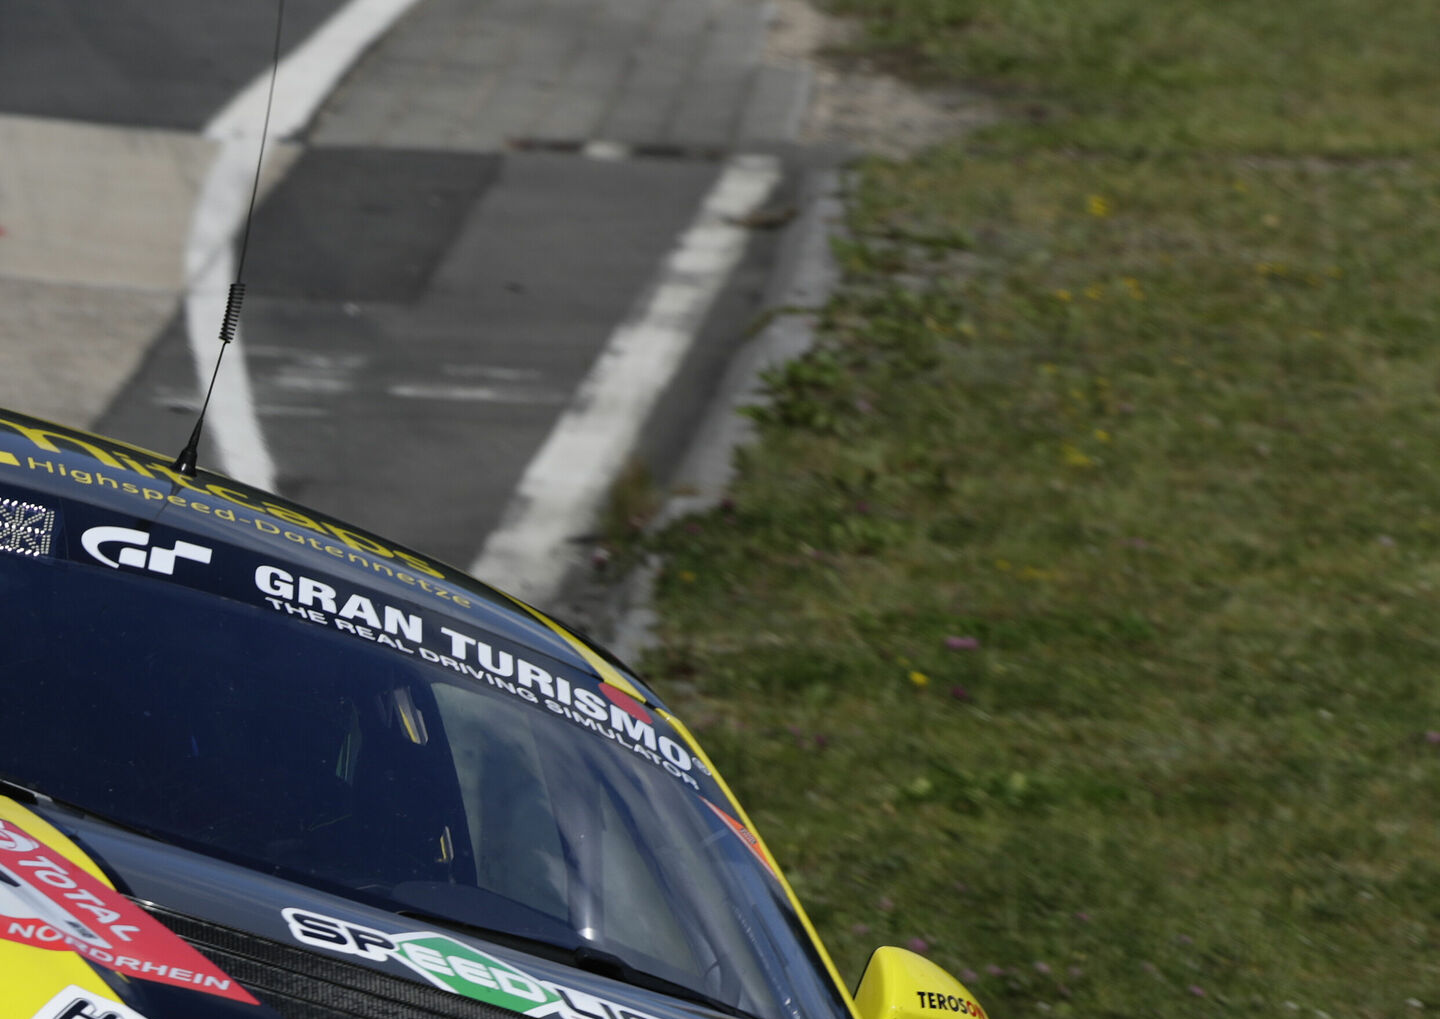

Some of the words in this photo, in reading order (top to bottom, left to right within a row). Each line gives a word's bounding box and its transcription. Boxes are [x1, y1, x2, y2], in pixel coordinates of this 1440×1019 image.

[27, 457, 472, 608] Highspeed-Datennetze
[255, 565, 422, 644] GRAN
[265, 597, 328, 625] THE
[335, 618, 415, 654] REAL
[420, 648, 538, 703] DRIVING
[546, 701, 699, 790] SIMULATOR
[17, 856, 141, 942] TOTAL
